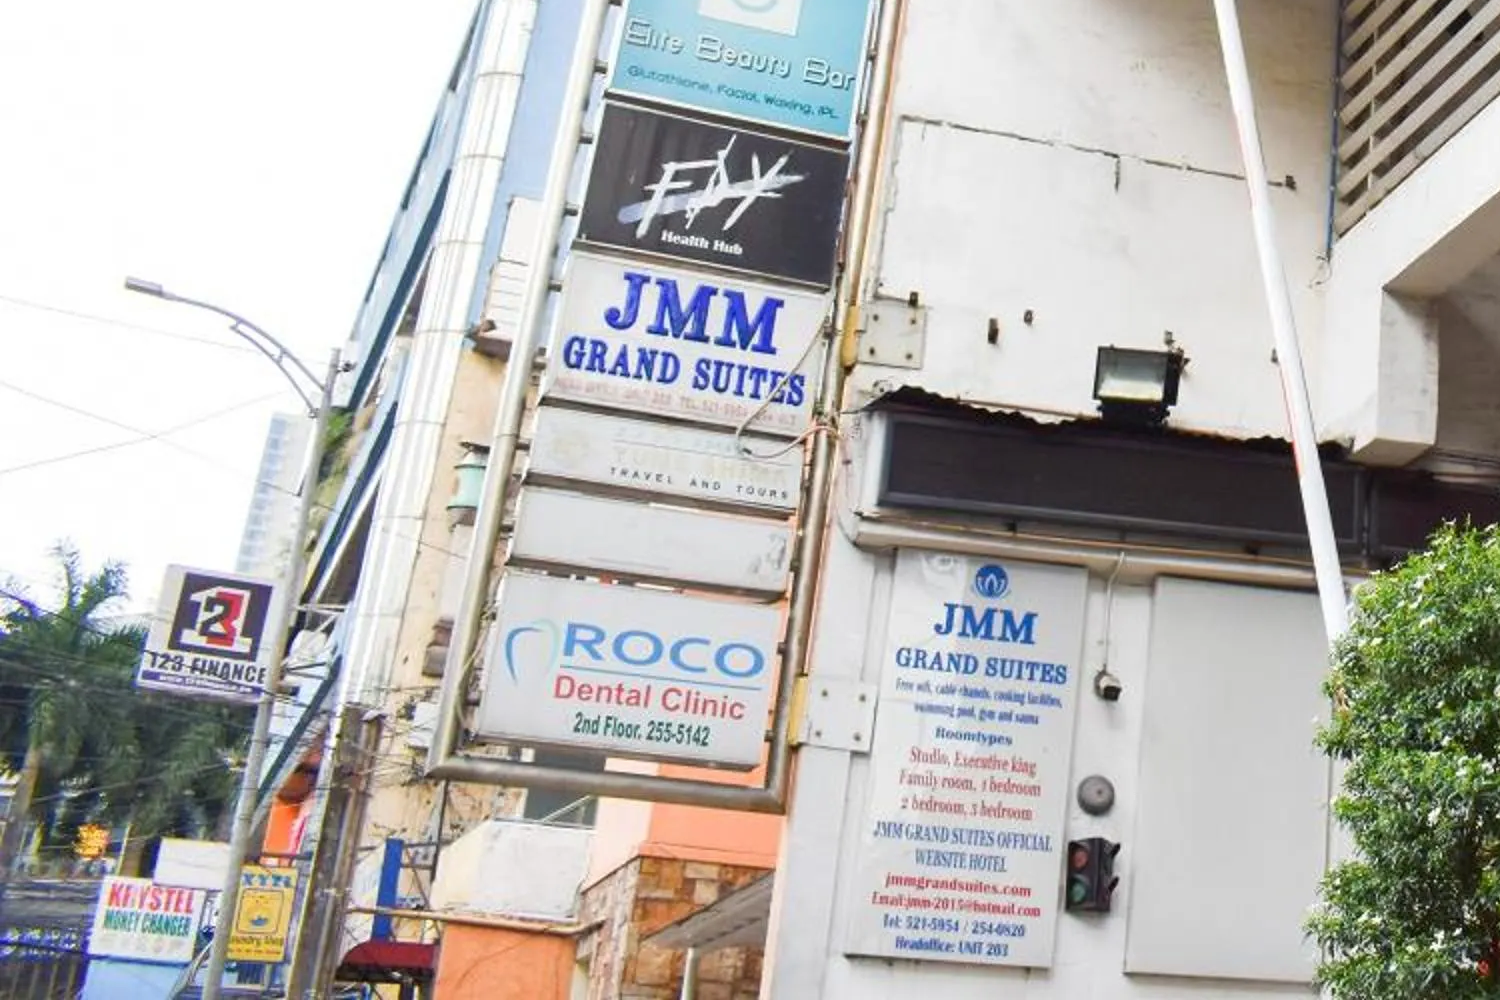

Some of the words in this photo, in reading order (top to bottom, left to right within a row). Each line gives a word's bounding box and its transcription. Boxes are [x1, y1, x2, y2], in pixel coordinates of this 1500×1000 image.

[697, 34, 791, 79] Beauty
[803, 57, 856, 92] Bar
[661, 229, 710, 251] Health
[713, 238, 744, 256] Hub
[603, 271, 786, 355] JMM
[563, 335, 682, 385] GRAND
[692, 356, 807, 407] SUITES
[609, 466, 673, 485] TRAVEL
[689, 478, 722, 491] AND
[736, 485, 789, 500] TOURS
[933, 602, 1039, 645] JMM
[562, 622, 765, 679] ROCO
[895, 647, 979, 676] GRAND
[985, 657, 1068, 686] SUITES
[150, 651, 185, 672] 123
[190, 657, 267, 685] FINANCE
[554, 674, 651, 710] Dental
[660, 686, 747, 722] Clinic
[573, 712, 600, 735] 2nd
[645, 719, 711, 748] 255-5142
[934, 726, 1013, 746] Roomtypes
[899, 769, 938, 791] Family
[989, 775, 1042, 797] bedroom
[979, 799, 1033, 821] bedroom
[873, 819, 903, 839] JMM
[904, 823, 949, 844] GRAND
[950, 827, 994, 847] SUITES
[996, 831, 1053, 852] OFFICIAL
[914, 849, 968, 870] WEBSITE
[968, 853, 1008, 873] HOTEL
[884, 871, 1032, 898] jmmgrandsuites.com
[103, 908, 141, 933] MONEY
[141, 911, 193, 937] CHANGER
[958, 939, 985, 955] UNIT
